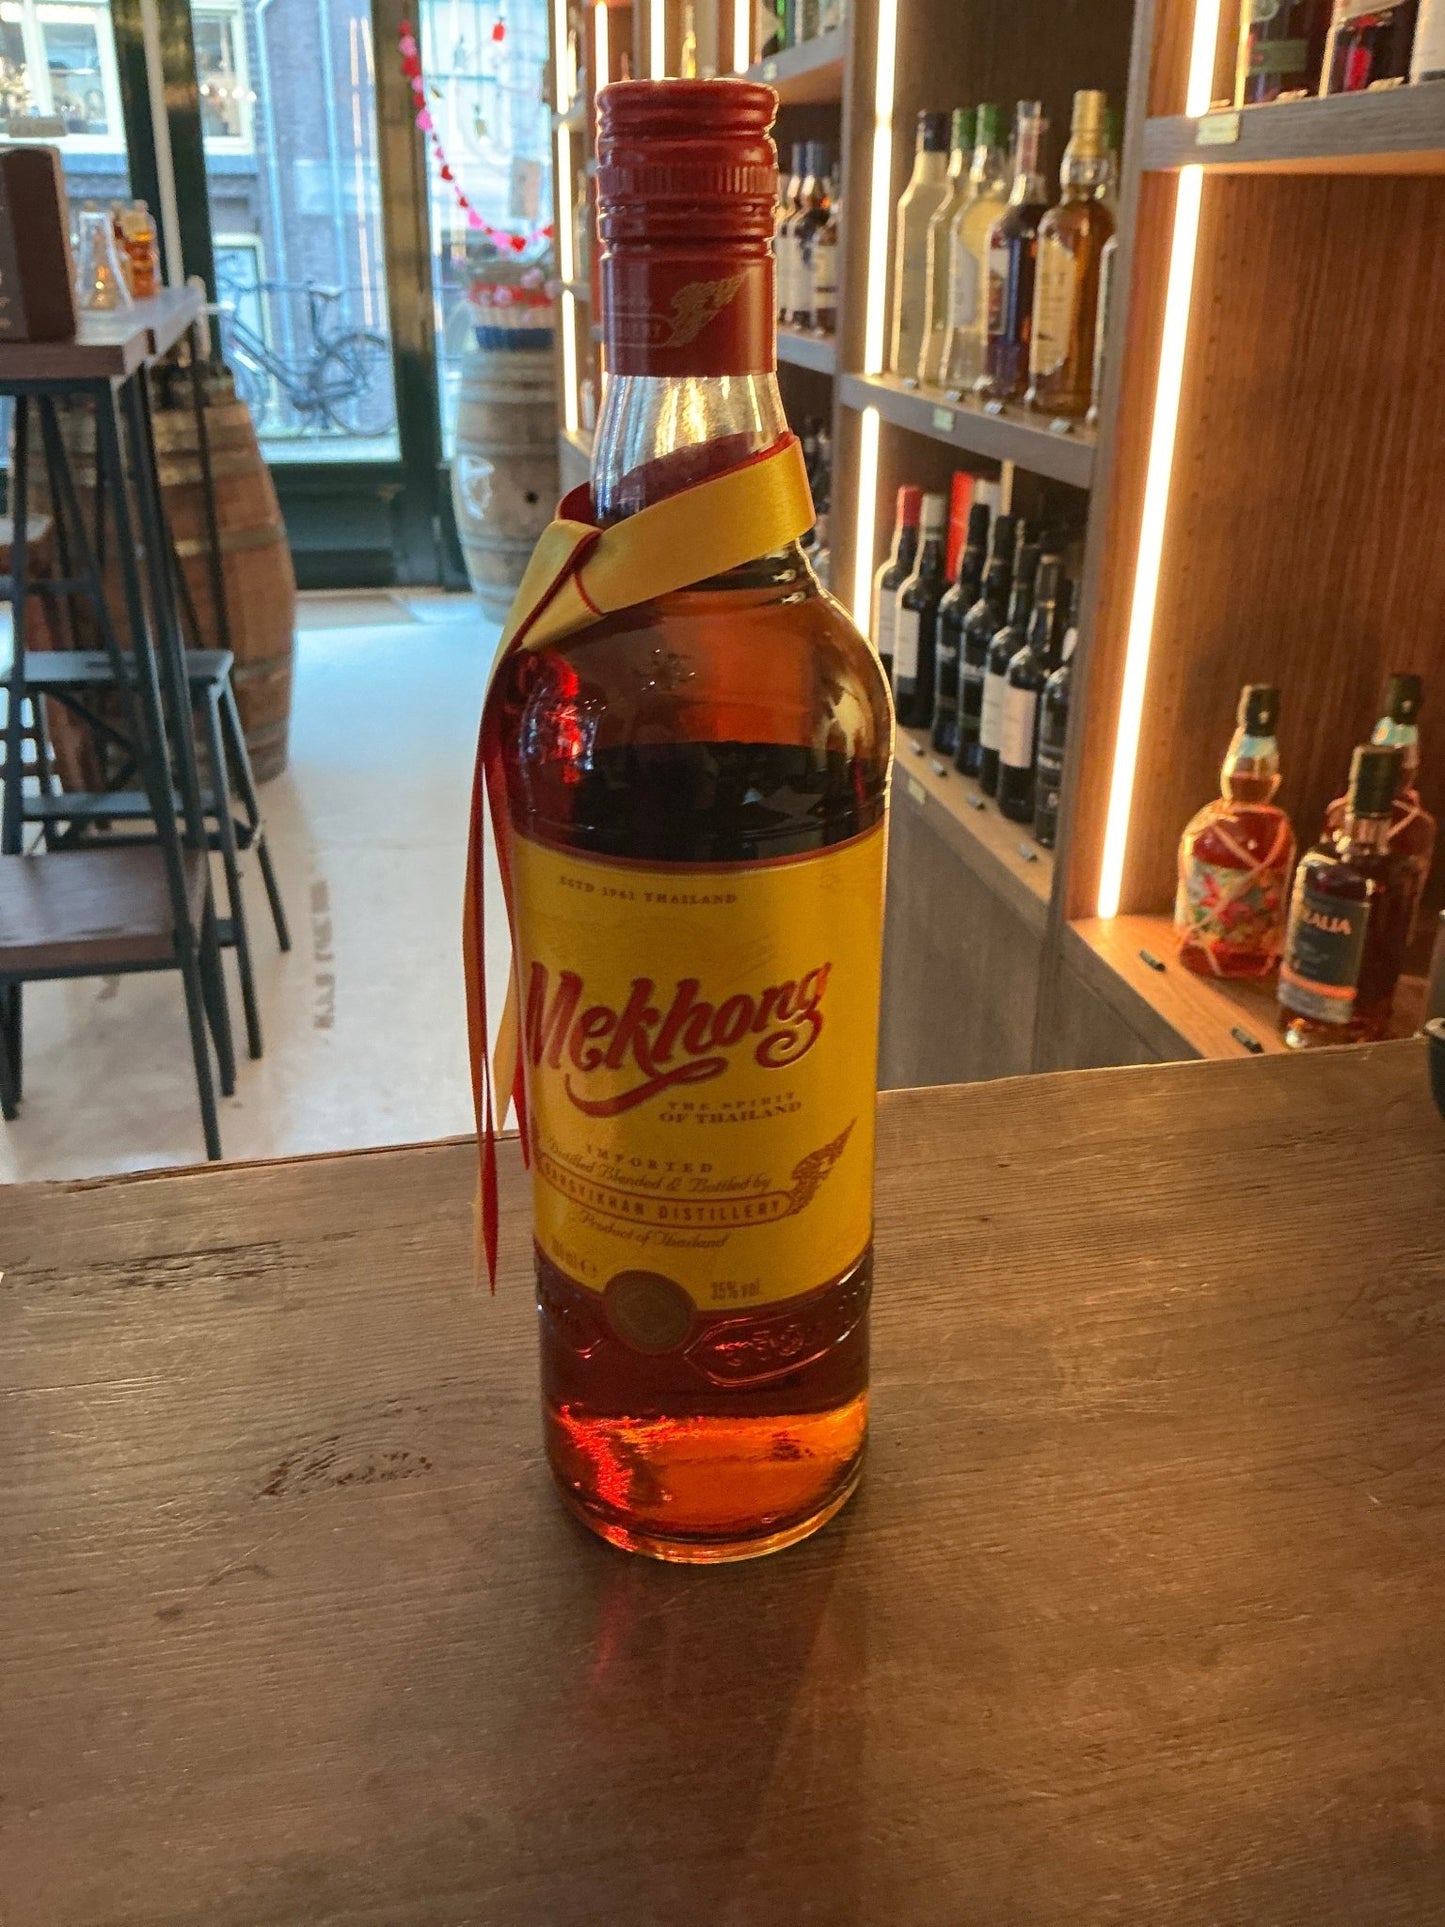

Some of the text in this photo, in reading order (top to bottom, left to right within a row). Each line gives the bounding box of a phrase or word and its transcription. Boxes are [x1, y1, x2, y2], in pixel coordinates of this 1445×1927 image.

[644, 891, 738, 905] THAILAND
[525, 961, 832, 1118] Mekhong
[659, 1101, 802, 1124] OF THAILAND
[668, 1101, 709, 1112] THE
[587, 1144, 713, 1173] IMPORTED
[658, 1200, 779, 1221] DISTILLERY
